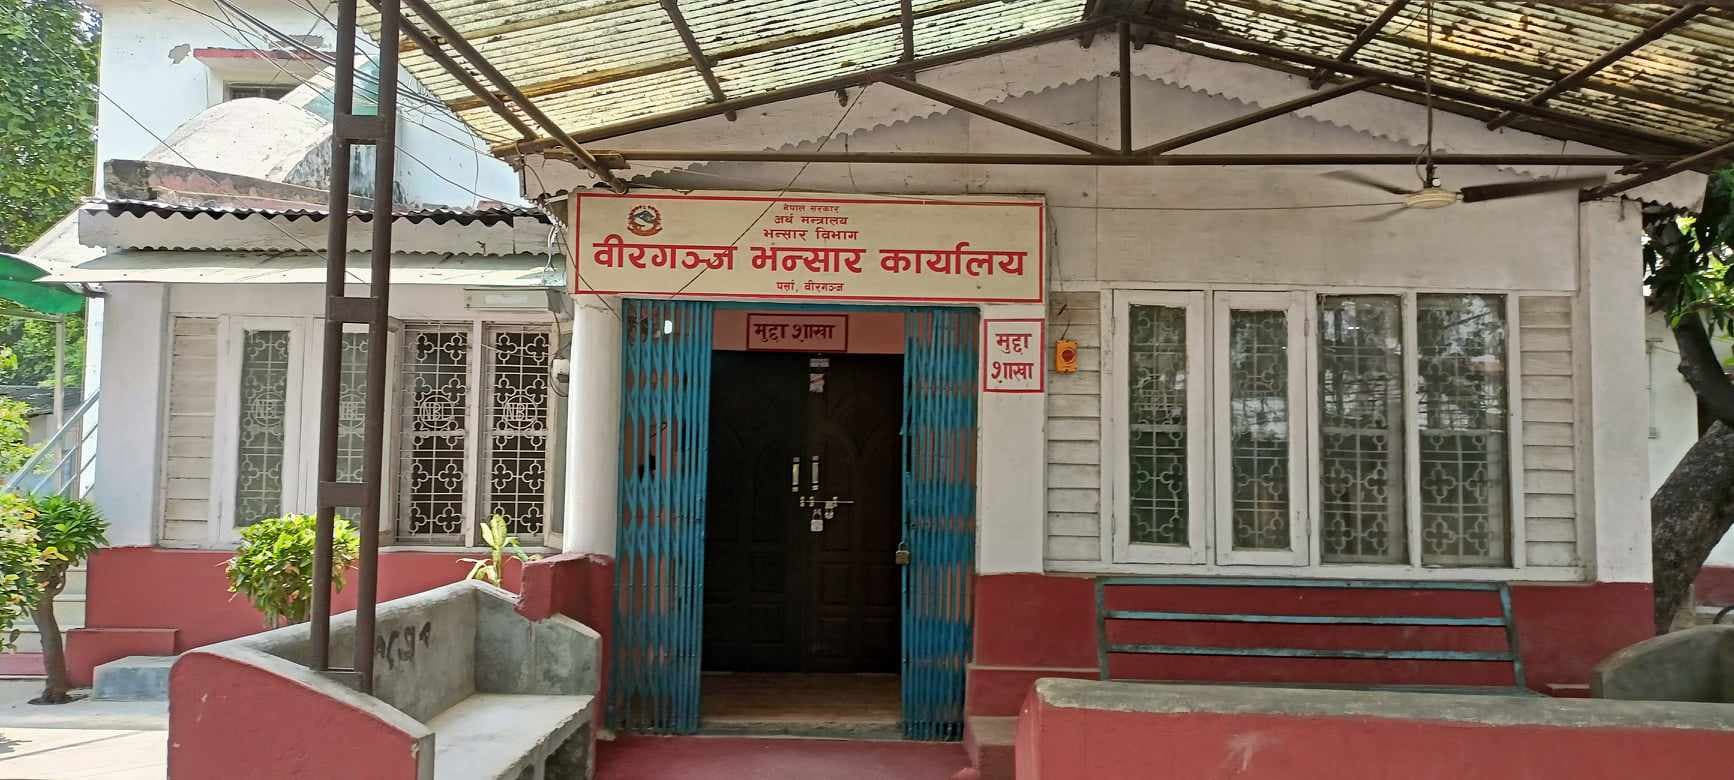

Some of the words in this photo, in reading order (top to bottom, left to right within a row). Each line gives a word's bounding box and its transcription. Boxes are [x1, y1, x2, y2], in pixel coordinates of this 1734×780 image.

[774, 213, 794, 225] अर्थ
[801, 216, 848, 226] मन्त्रालय
[763, 229, 808, 241] भन्सार
[816, 227, 859, 240] विभाग
[592, 233, 738, 270] वीरगञ्ज
[750, 246, 867, 274] भन्सार
[879, 242, 1028, 276] कार्यालय
[753, 323, 789, 343] मुद्दा
[792, 323, 836, 343] शाखा
[995, 333, 1032, 355] मुद्दा
[991, 361, 1034, 383] शाखा
